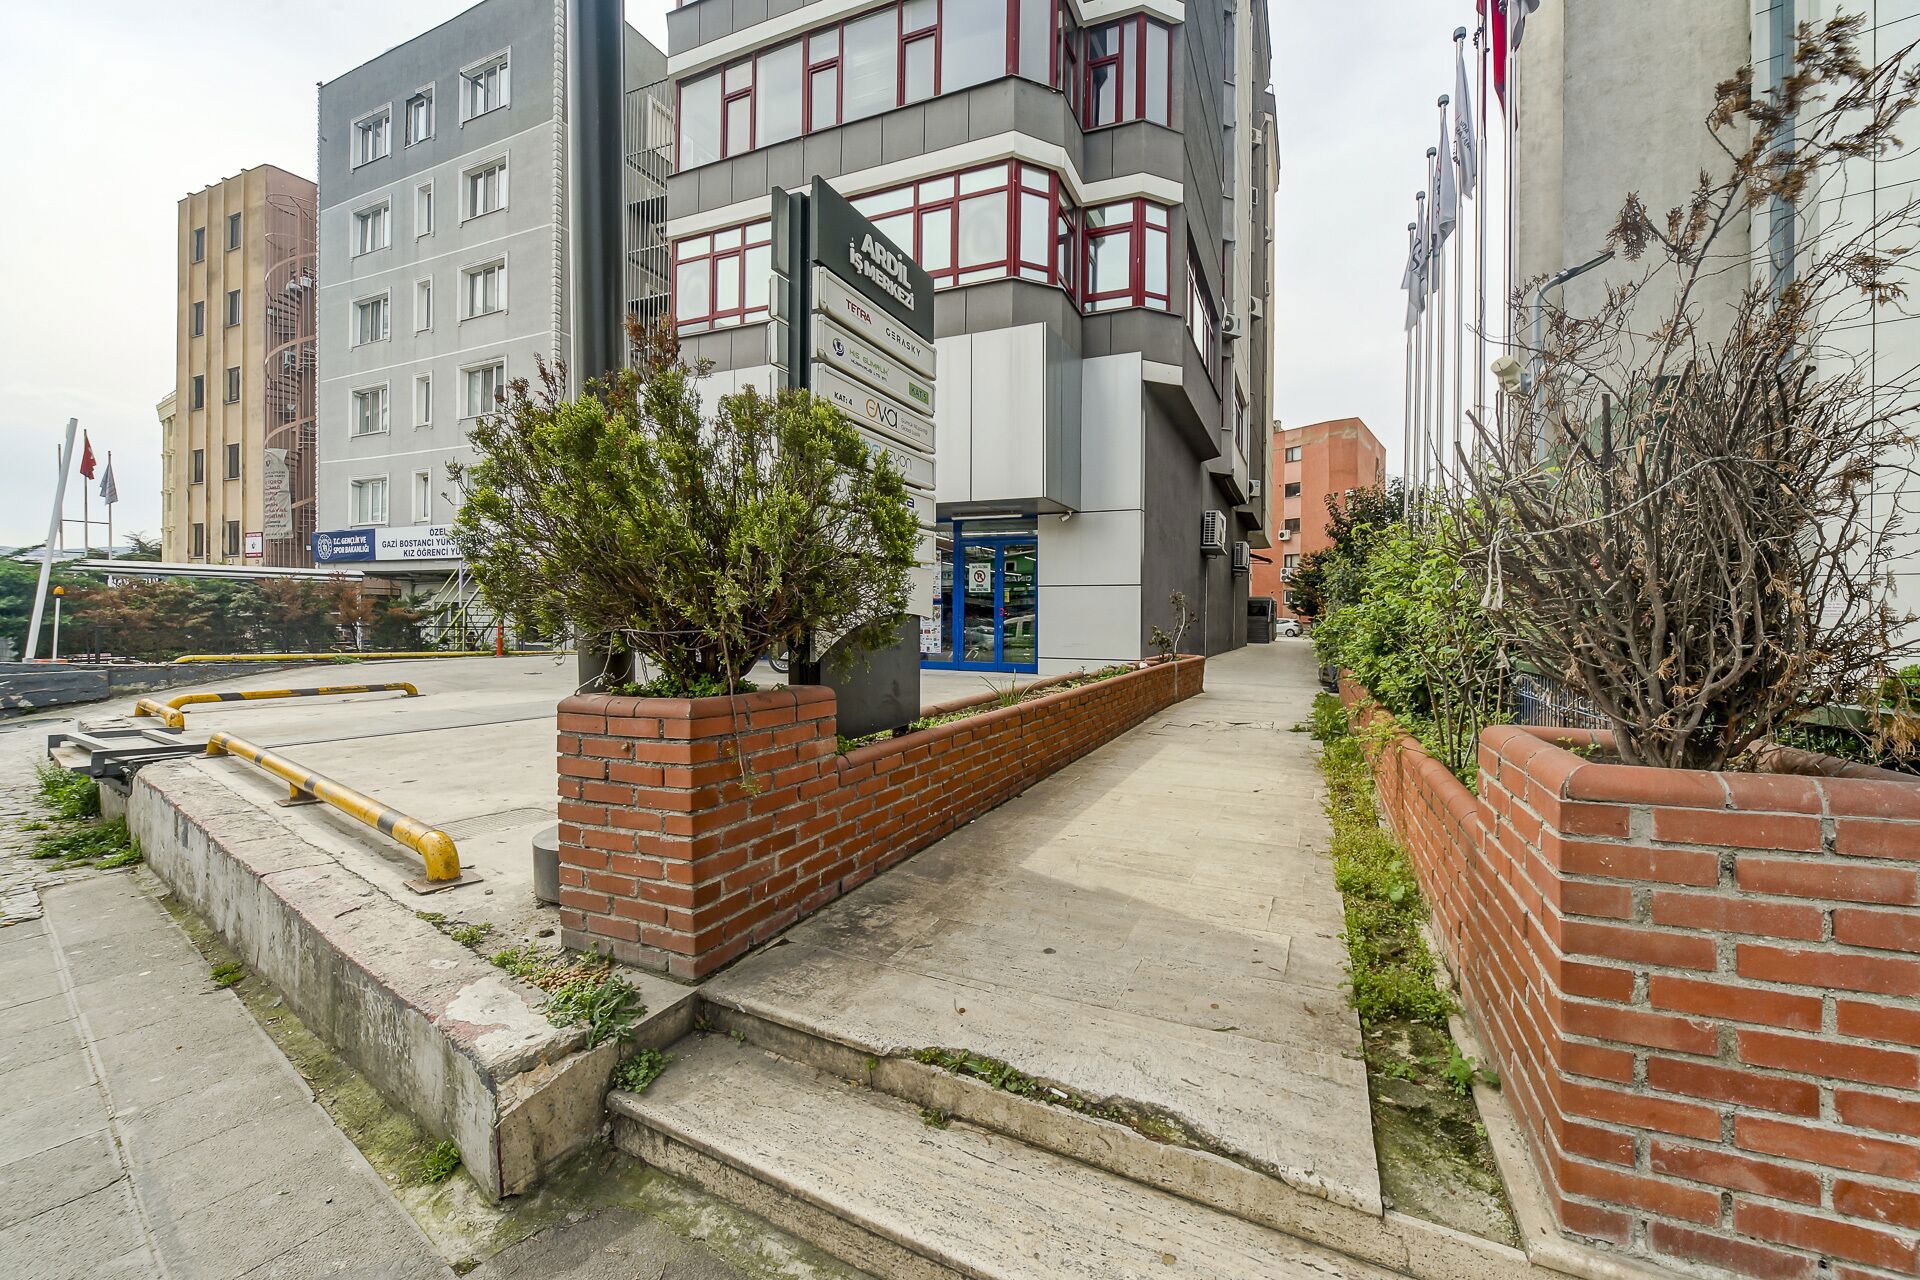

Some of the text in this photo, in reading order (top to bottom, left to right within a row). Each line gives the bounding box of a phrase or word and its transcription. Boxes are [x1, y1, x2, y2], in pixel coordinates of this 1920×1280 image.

[861, 233, 912, 290] ARDİL
[849, 242, 915, 311] İŞ MERKEZİ
[845, 298, 872, 325] TETRA
[382, 538, 398, 549] GAZİ
[399, 538, 434, 548] BOSTANCI
[403, 549, 415, 558] KIZ
[416, 546, 449, 557] ÖĞRENCİ
